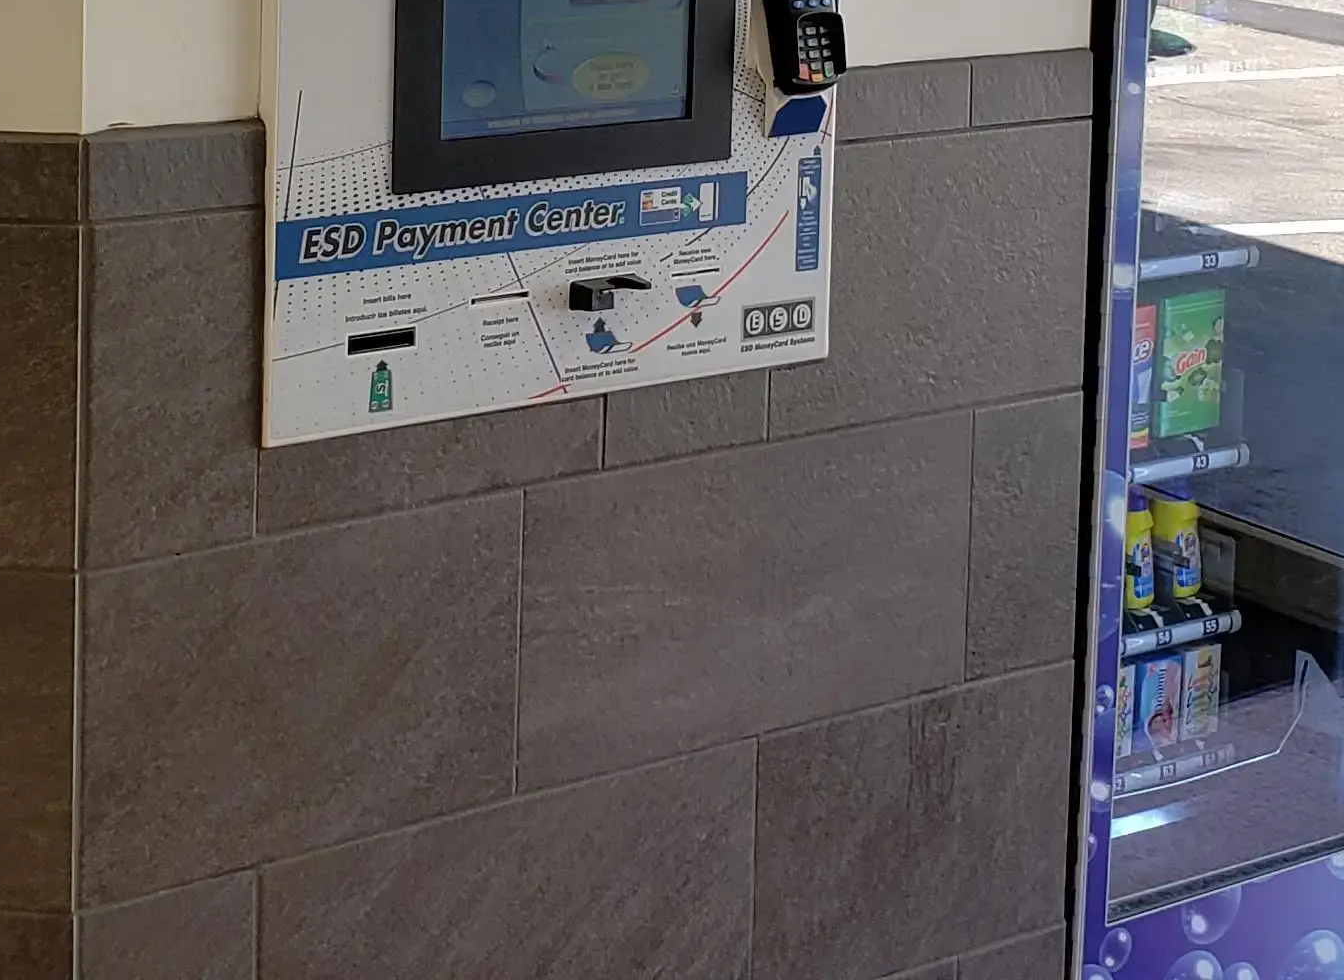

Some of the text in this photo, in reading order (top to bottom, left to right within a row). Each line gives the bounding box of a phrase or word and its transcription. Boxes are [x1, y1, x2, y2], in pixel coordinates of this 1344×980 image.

[300, 222, 366, 263] ESD
[373, 208, 520, 260] Payment
[568, 258, 584, 266] Insert
[585, 254, 616, 263] MoneyCard
[363, 296, 381, 304] Insert
[755, 339, 788, 350] MoneyCard
[790, 337, 814, 346] Systems
[1174, 349, 1206, 375] Gain
[1195, 457, 1206, 468] 43
[1206, 620, 1216, 632] 55
[1158, 631, 1170, 644] 54
